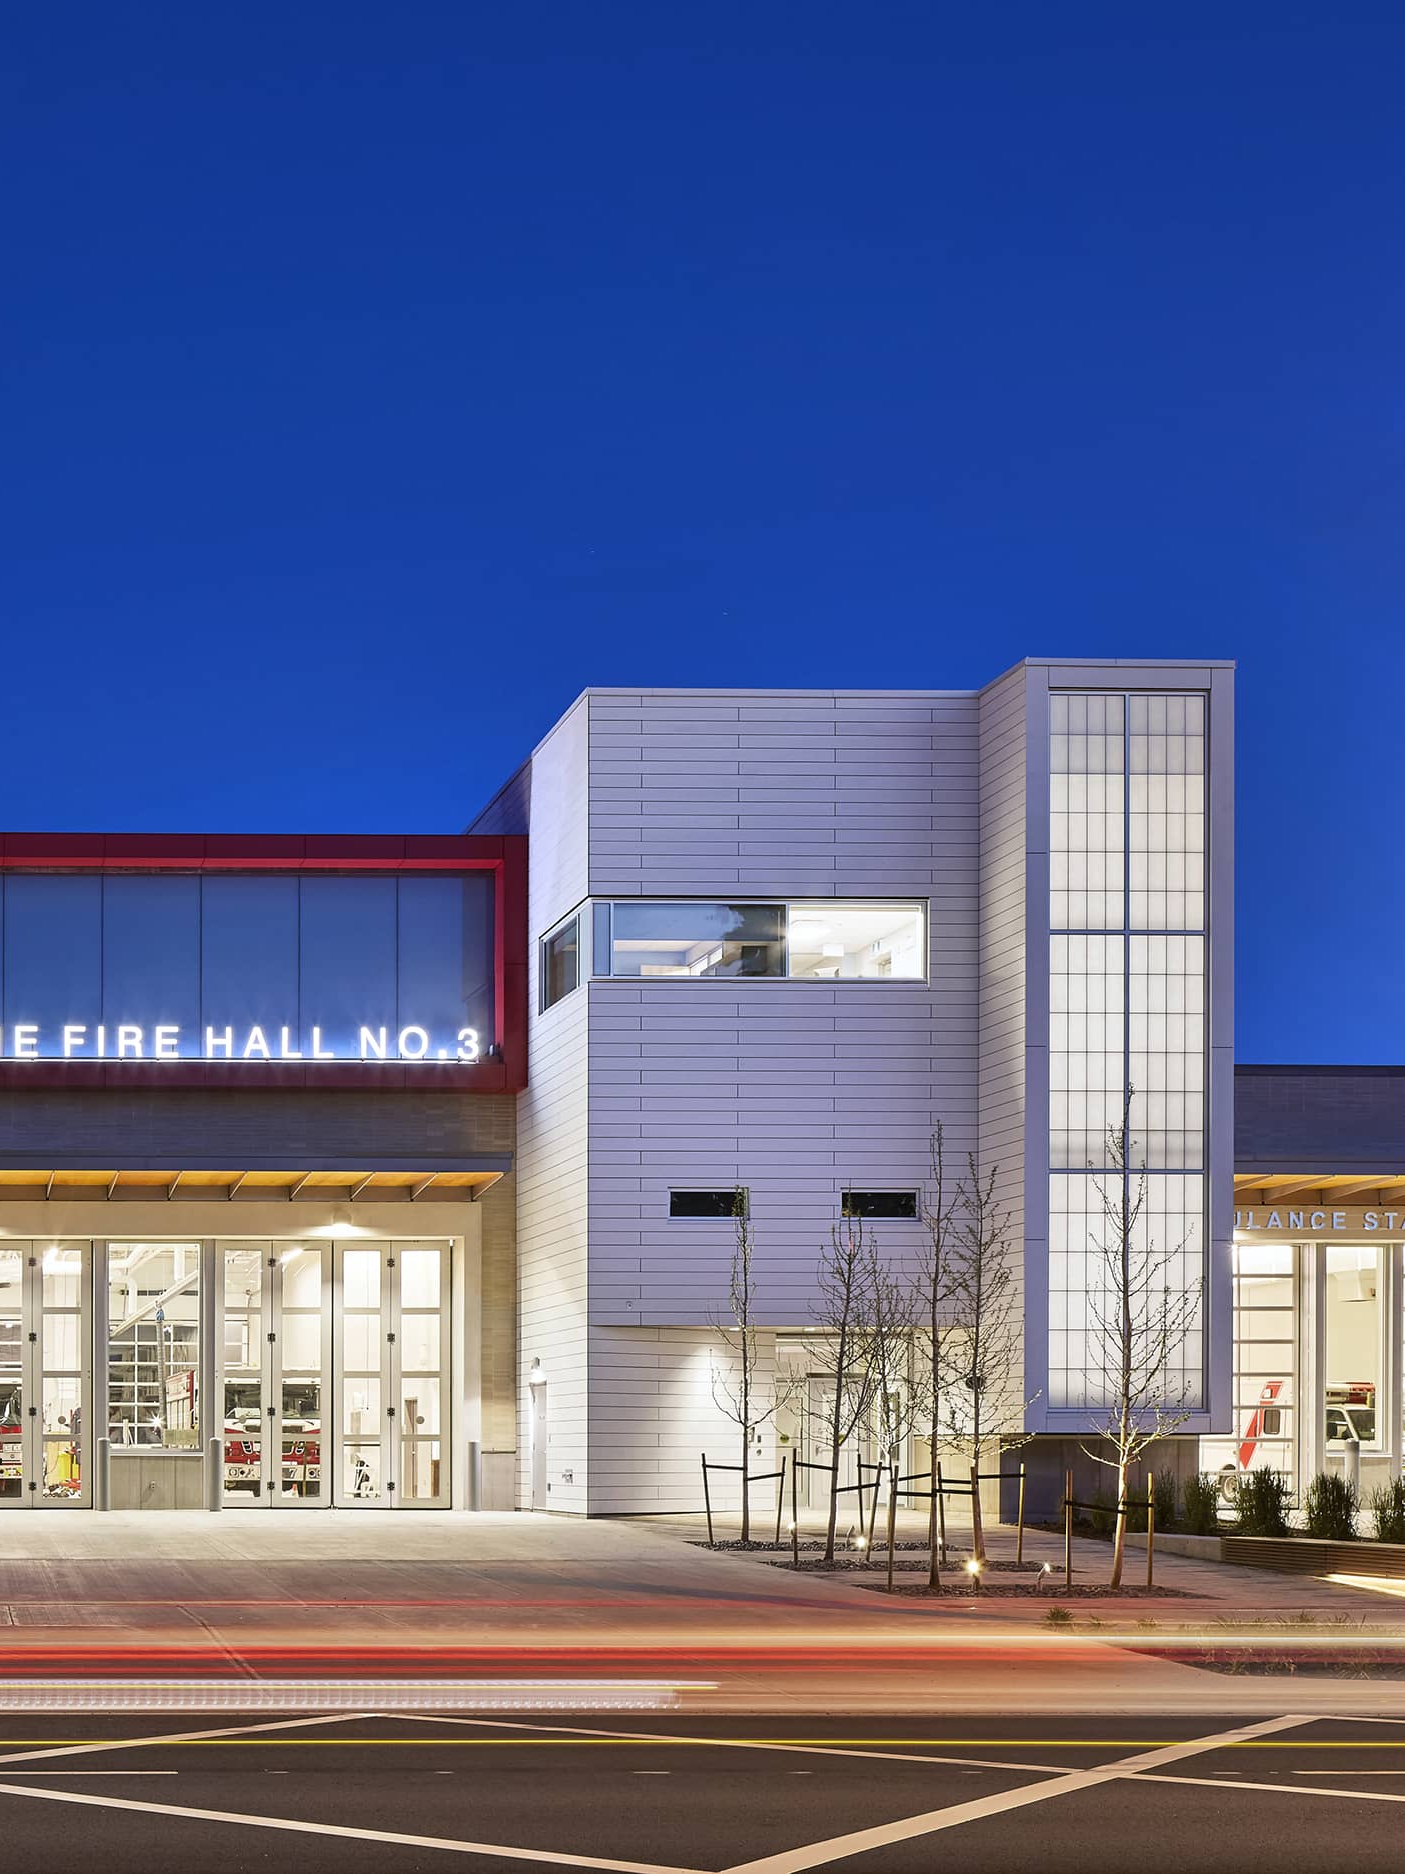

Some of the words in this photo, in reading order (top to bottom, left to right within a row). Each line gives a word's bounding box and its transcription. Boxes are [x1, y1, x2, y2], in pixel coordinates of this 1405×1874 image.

[63, 1025, 179, 1058] FIRE
[205, 1025, 335, 1059] HALL
[359, 1025, 480, 1060] NO.3
[1363, 1212, 1405, 1230] ST
